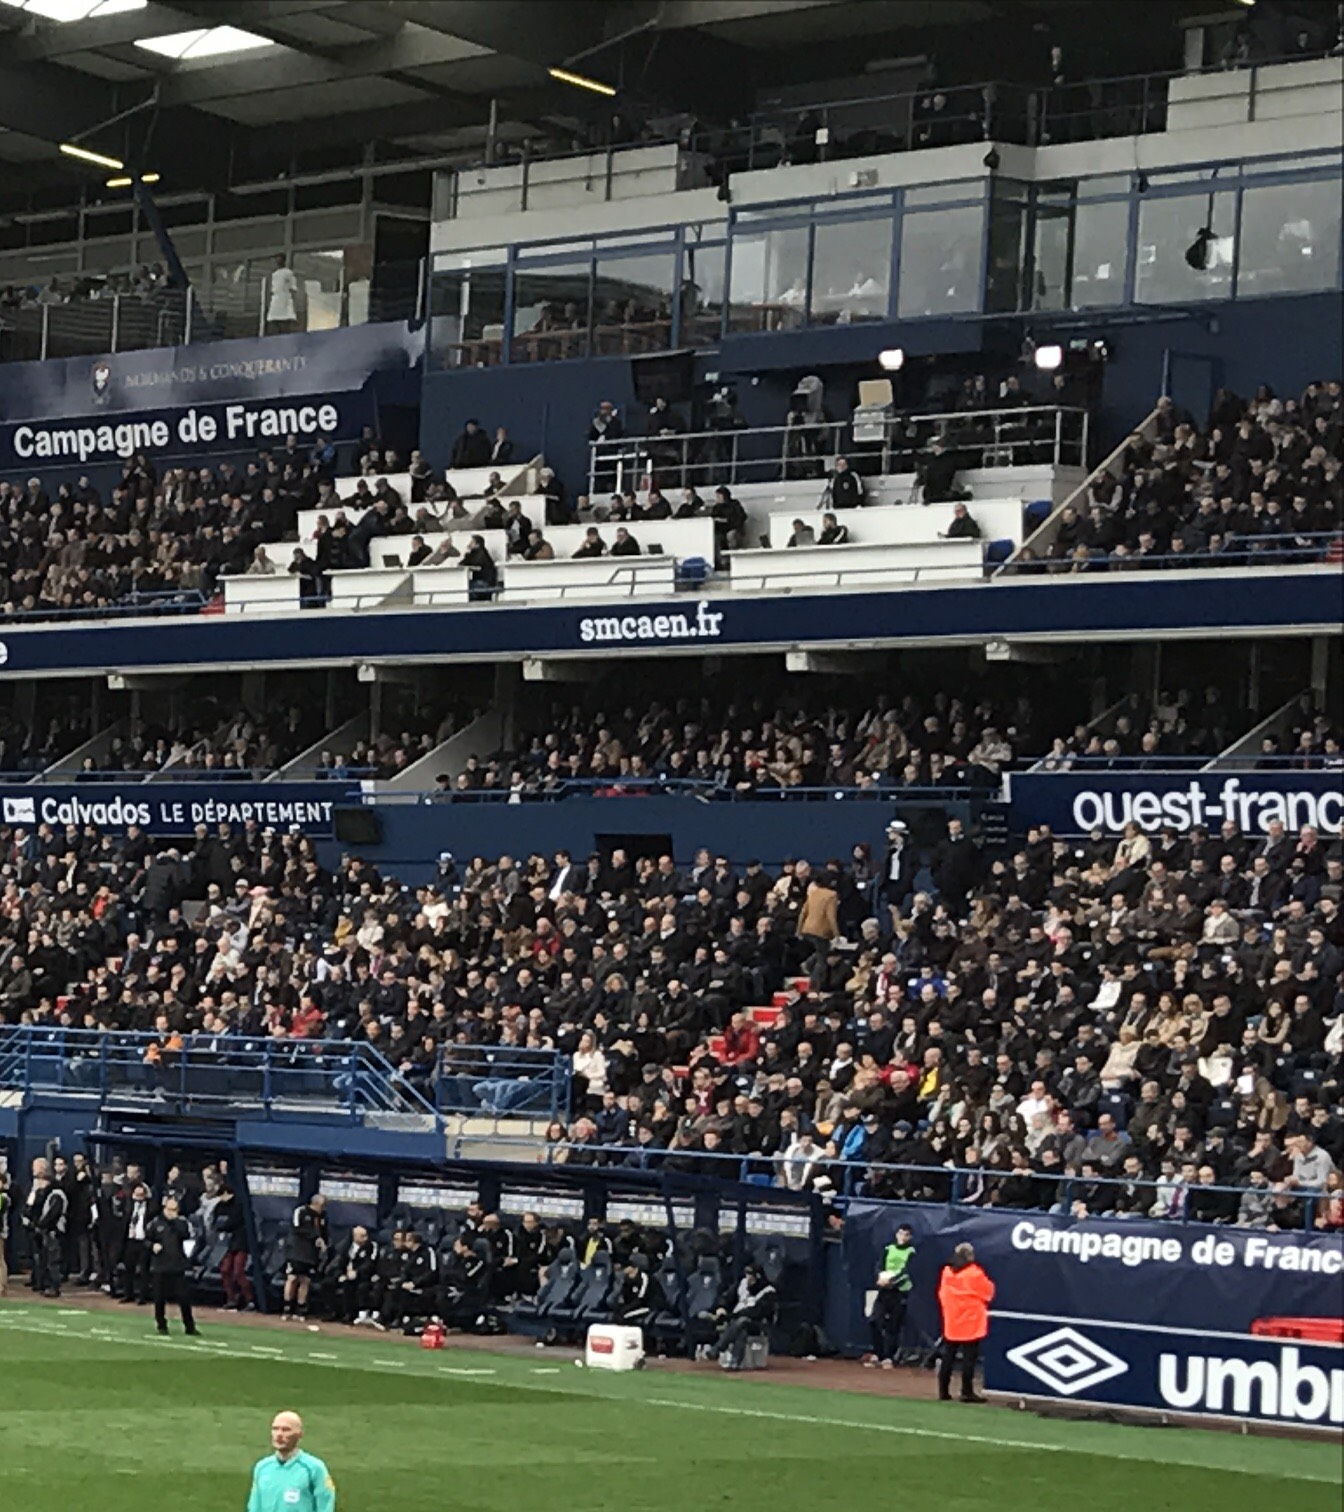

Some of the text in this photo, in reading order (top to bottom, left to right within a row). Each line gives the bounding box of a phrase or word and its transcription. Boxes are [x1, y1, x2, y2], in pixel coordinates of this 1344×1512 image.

[14, 404, 338, 461] Campagne de France
[580, 600, 723, 641] smcaen.fr
[42, 796, 334, 824] Calvados LE DÉPARTEMENT
[1012, 1222, 1181, 1267] Campagne
[1191, 1234, 1235, 1267] de
